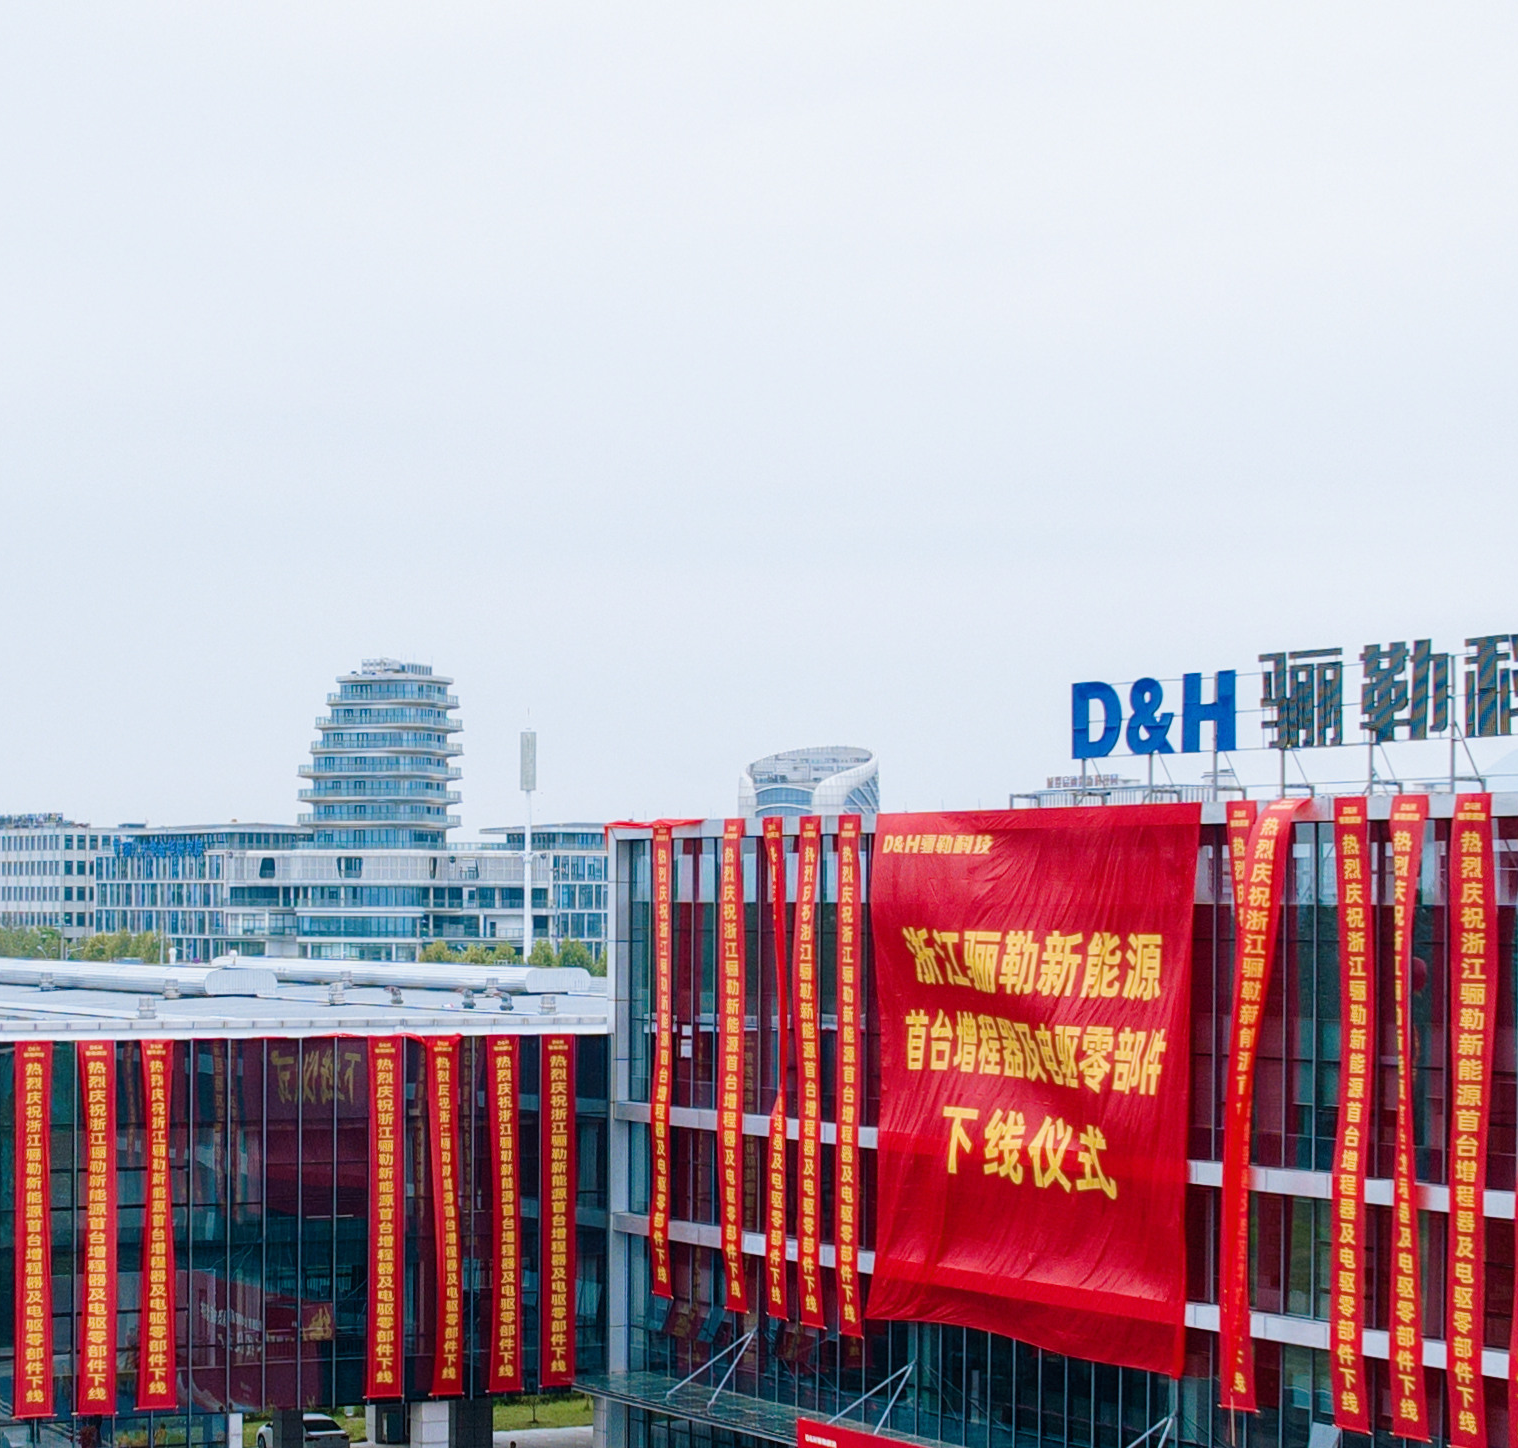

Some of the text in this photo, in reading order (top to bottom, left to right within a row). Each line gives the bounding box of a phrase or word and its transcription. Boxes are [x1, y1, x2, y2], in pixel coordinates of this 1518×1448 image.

[1070, 669, 1237, 760] D&H
[902, 926, 1163, 1001] 浙江骊勒新能源
[904, 1009, 1167, 1097] 首台增程器及电驱零部件
[375, 1057, 395, 1385] 热烈庆祝浙江骊勒新能源首台增程器及电驱零部件下线
[549, 1055, 569, 1373] 热烈庆祝浙江骊勒新能源首台增程器及电驱零部件下线
[942, 1105, 1118, 1200] 下线仪式
[1335, 832, 1368, 1415] 热烈庆祝浙江骊勒新能源首台增程器及电驱零部件下线
[1453, 830, 1487, 1436] 热烈庆祝浙江骊勒新能源首台增程器及电驱零部件下线
